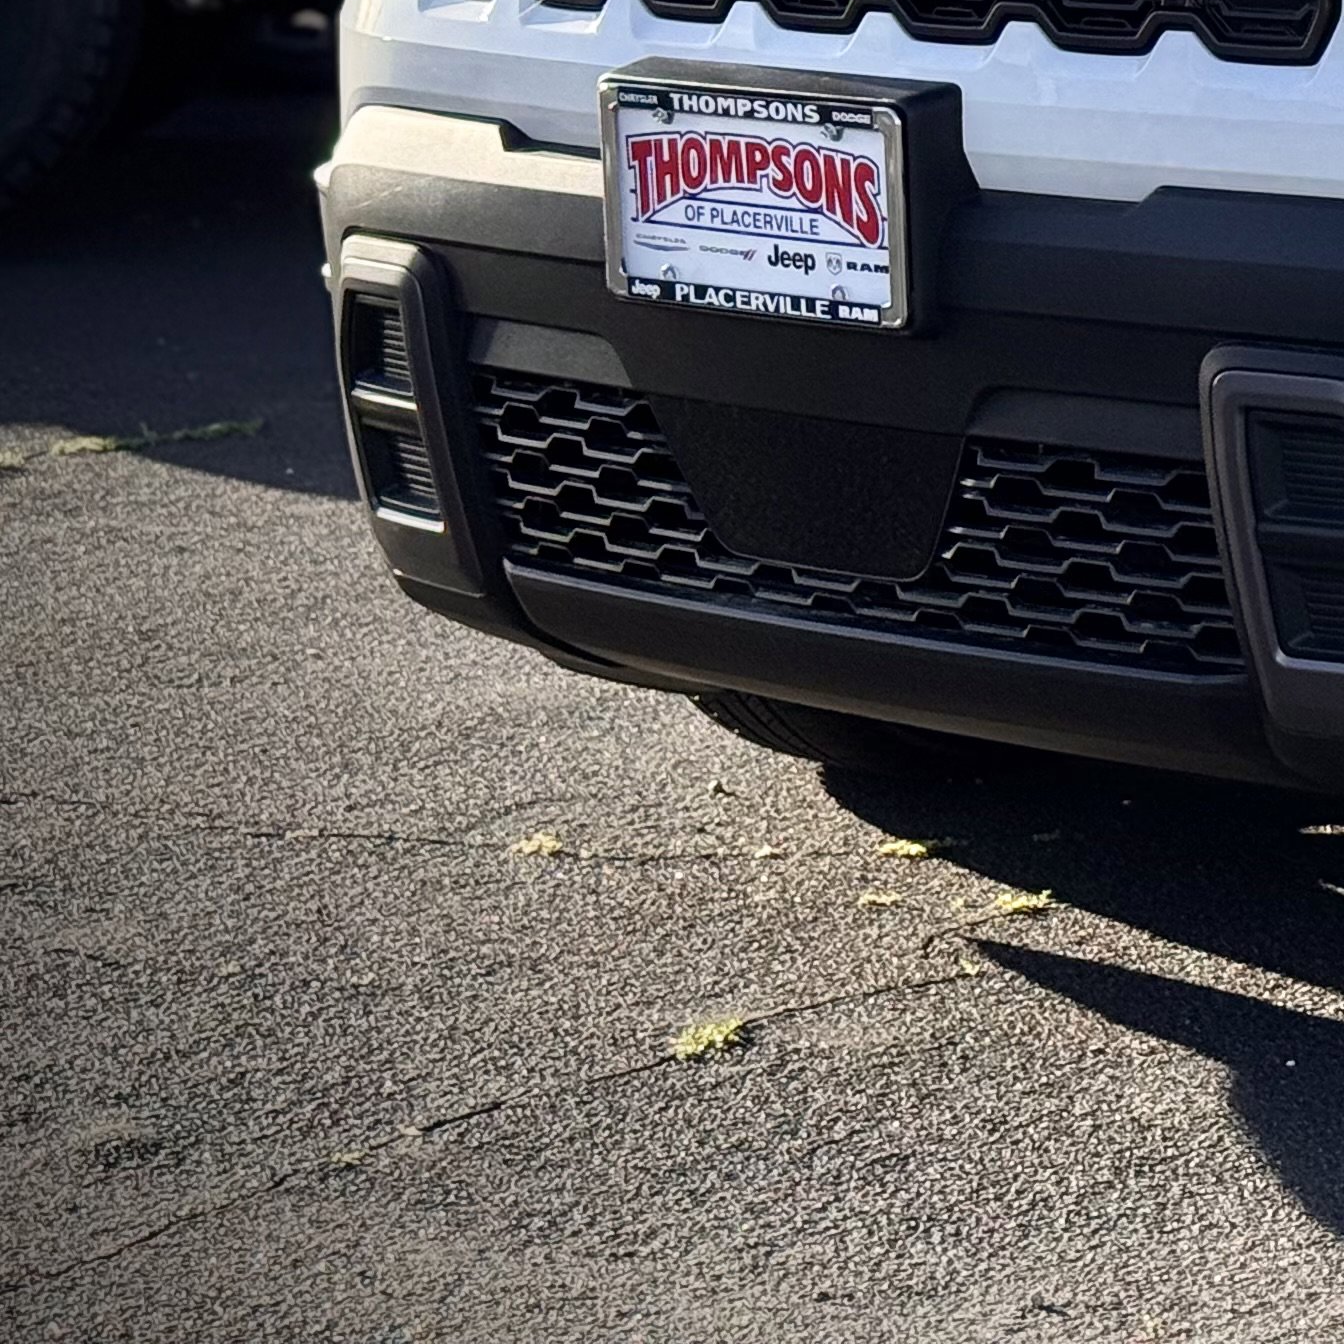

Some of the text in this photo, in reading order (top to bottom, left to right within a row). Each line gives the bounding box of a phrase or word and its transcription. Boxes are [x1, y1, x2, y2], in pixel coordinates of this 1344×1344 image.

[669, 92, 821, 124] THOMPSONS
[831, 111, 871, 124] DODGE
[628, 132, 884, 247] THOMPSONS
[684, 204, 820, 236] OF PLACERVILLE
[767, 244, 816, 275] Jeep
[846, 260, 890, 274] RAM
[631, 278, 661, 299] Jeep
[674, 283, 832, 319] PLACERVILLE
[838, 306, 879, 323] RAM
